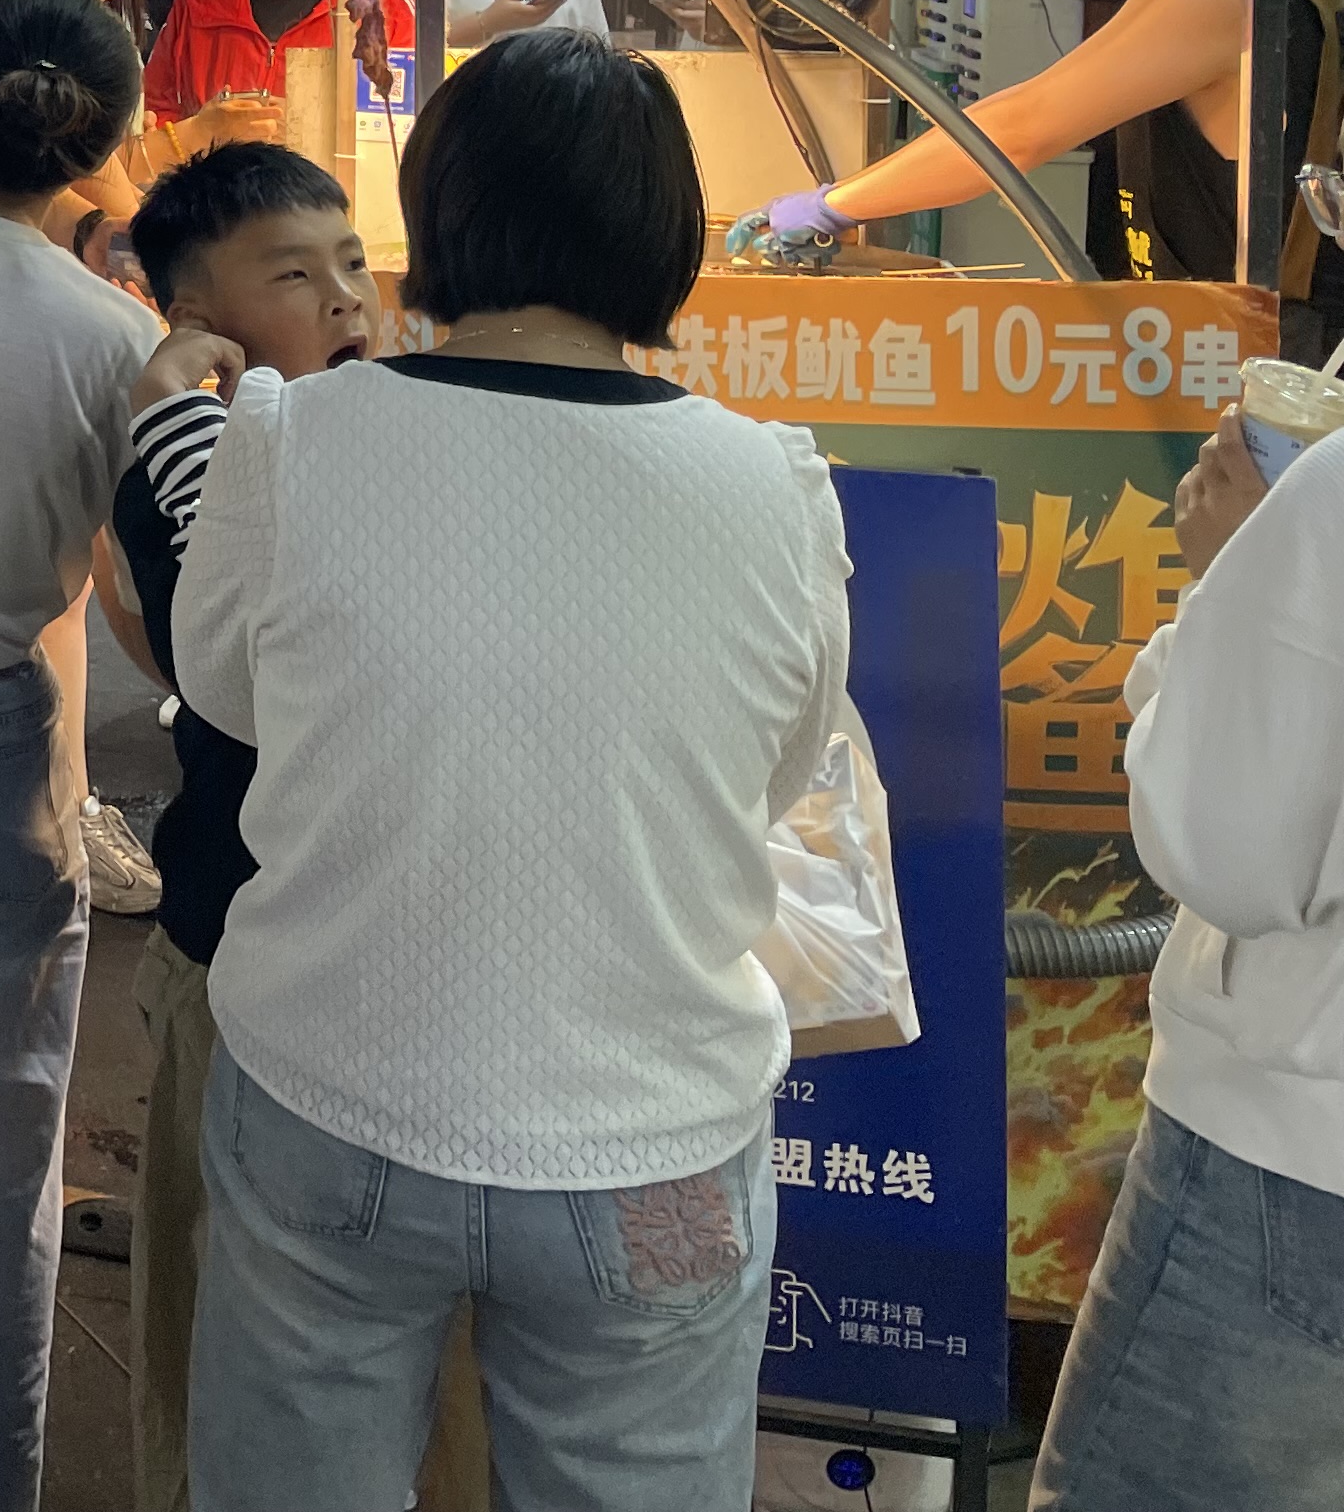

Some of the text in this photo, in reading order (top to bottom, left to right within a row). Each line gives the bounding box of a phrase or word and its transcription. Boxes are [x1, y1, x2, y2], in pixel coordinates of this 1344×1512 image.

[838, 1295, 925, 1329] 打开抖音
[838, 1319, 968, 1357] 搜索页扫一扫
